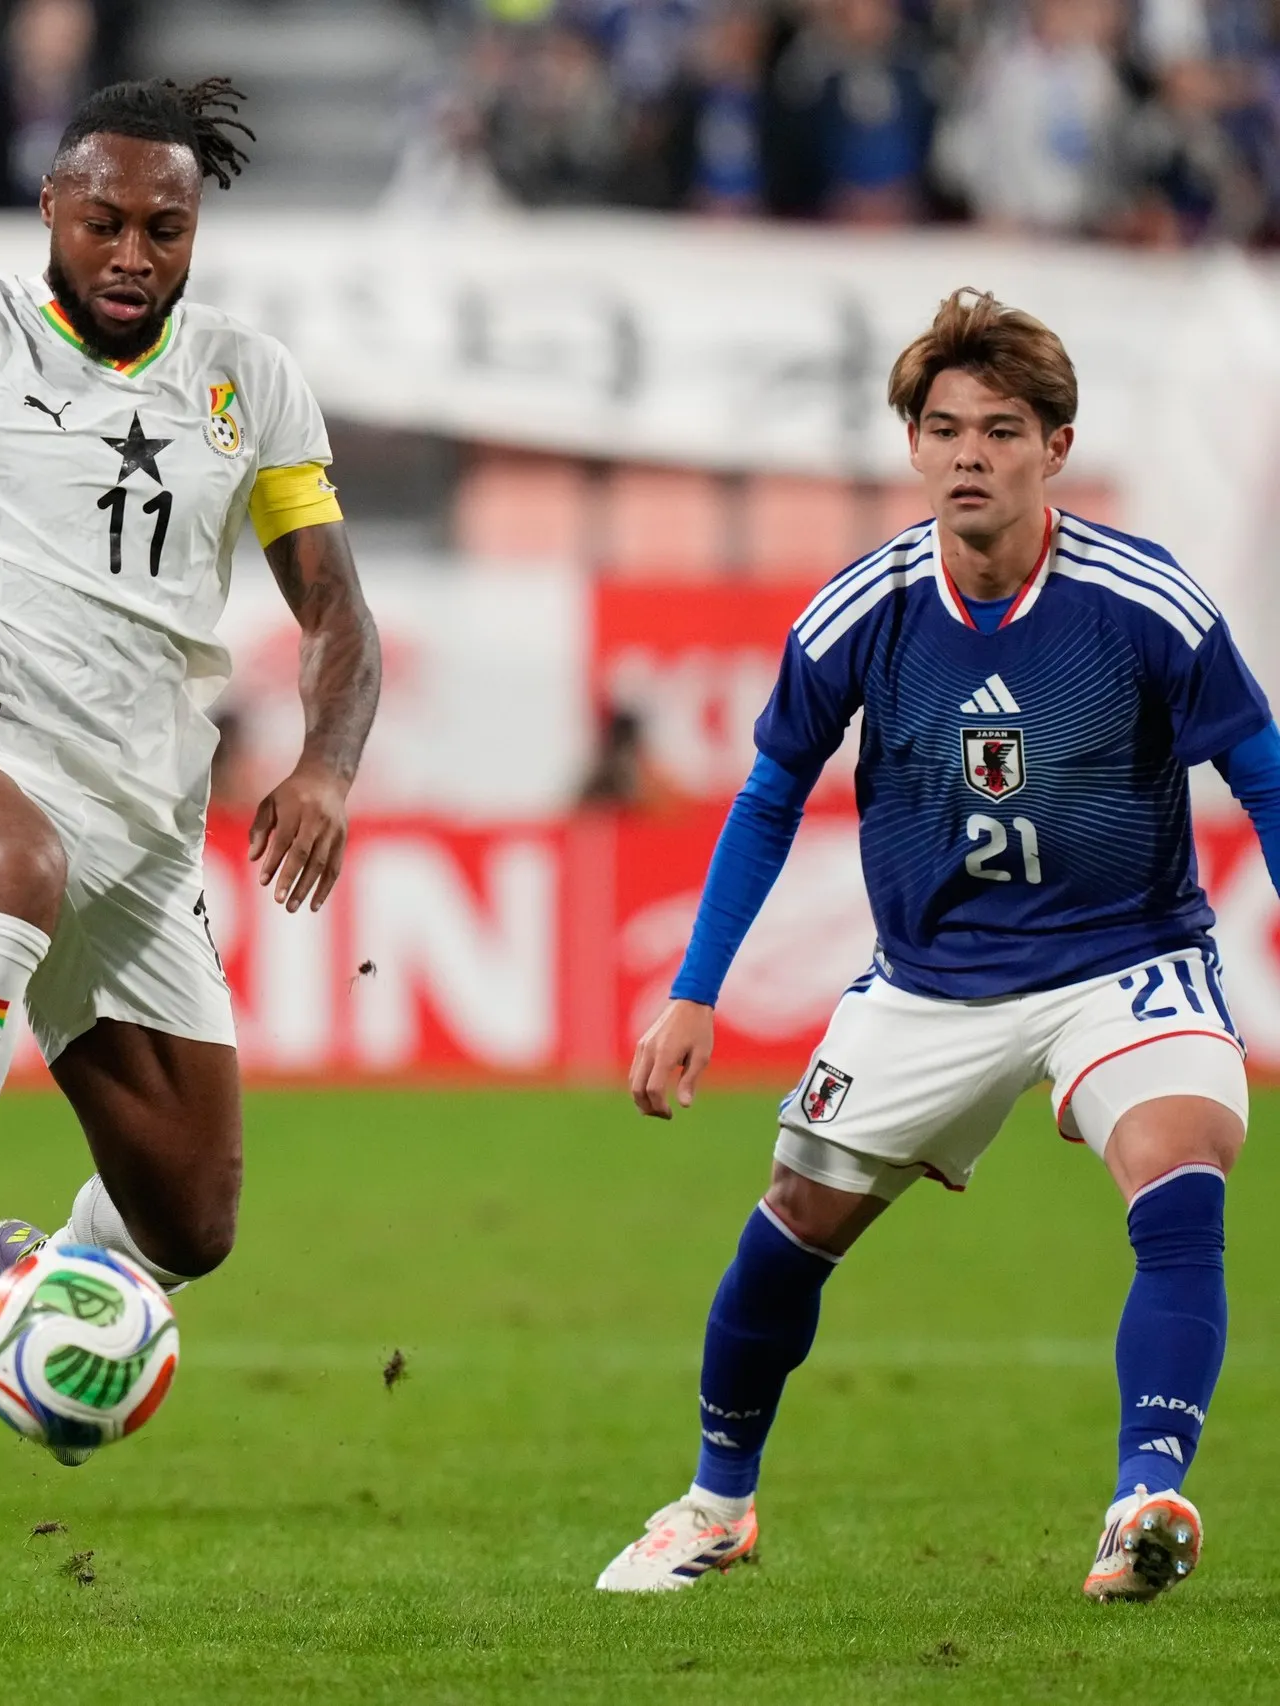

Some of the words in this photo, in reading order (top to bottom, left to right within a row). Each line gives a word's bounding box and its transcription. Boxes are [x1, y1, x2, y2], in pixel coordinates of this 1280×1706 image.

[97, 487, 173, 577] 11
[965, 813, 1042, 884] 21
[1118, 960, 1206, 1022] 21
